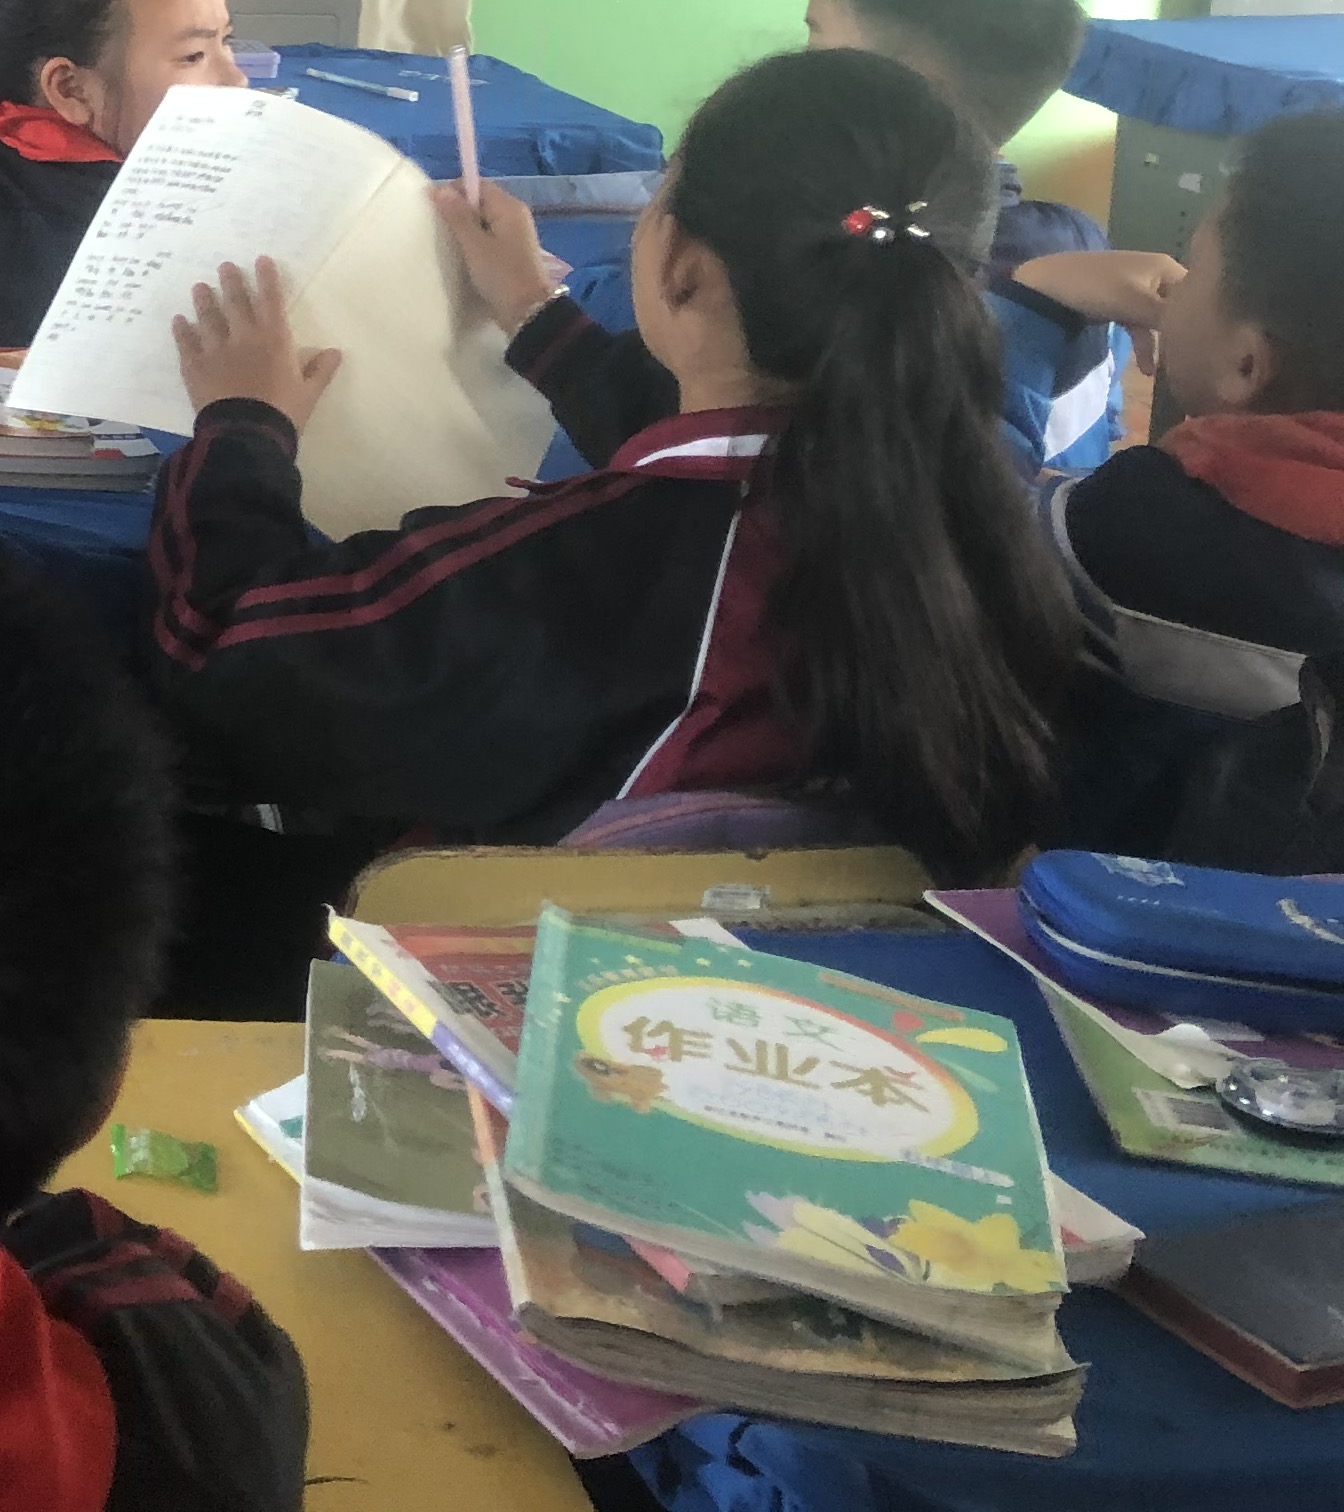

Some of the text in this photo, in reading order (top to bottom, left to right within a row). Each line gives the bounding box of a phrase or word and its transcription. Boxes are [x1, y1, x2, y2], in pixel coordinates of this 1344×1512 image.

[622, 1014, 932, 1112] 作业本
[709, 996, 846, 1053] 语文
